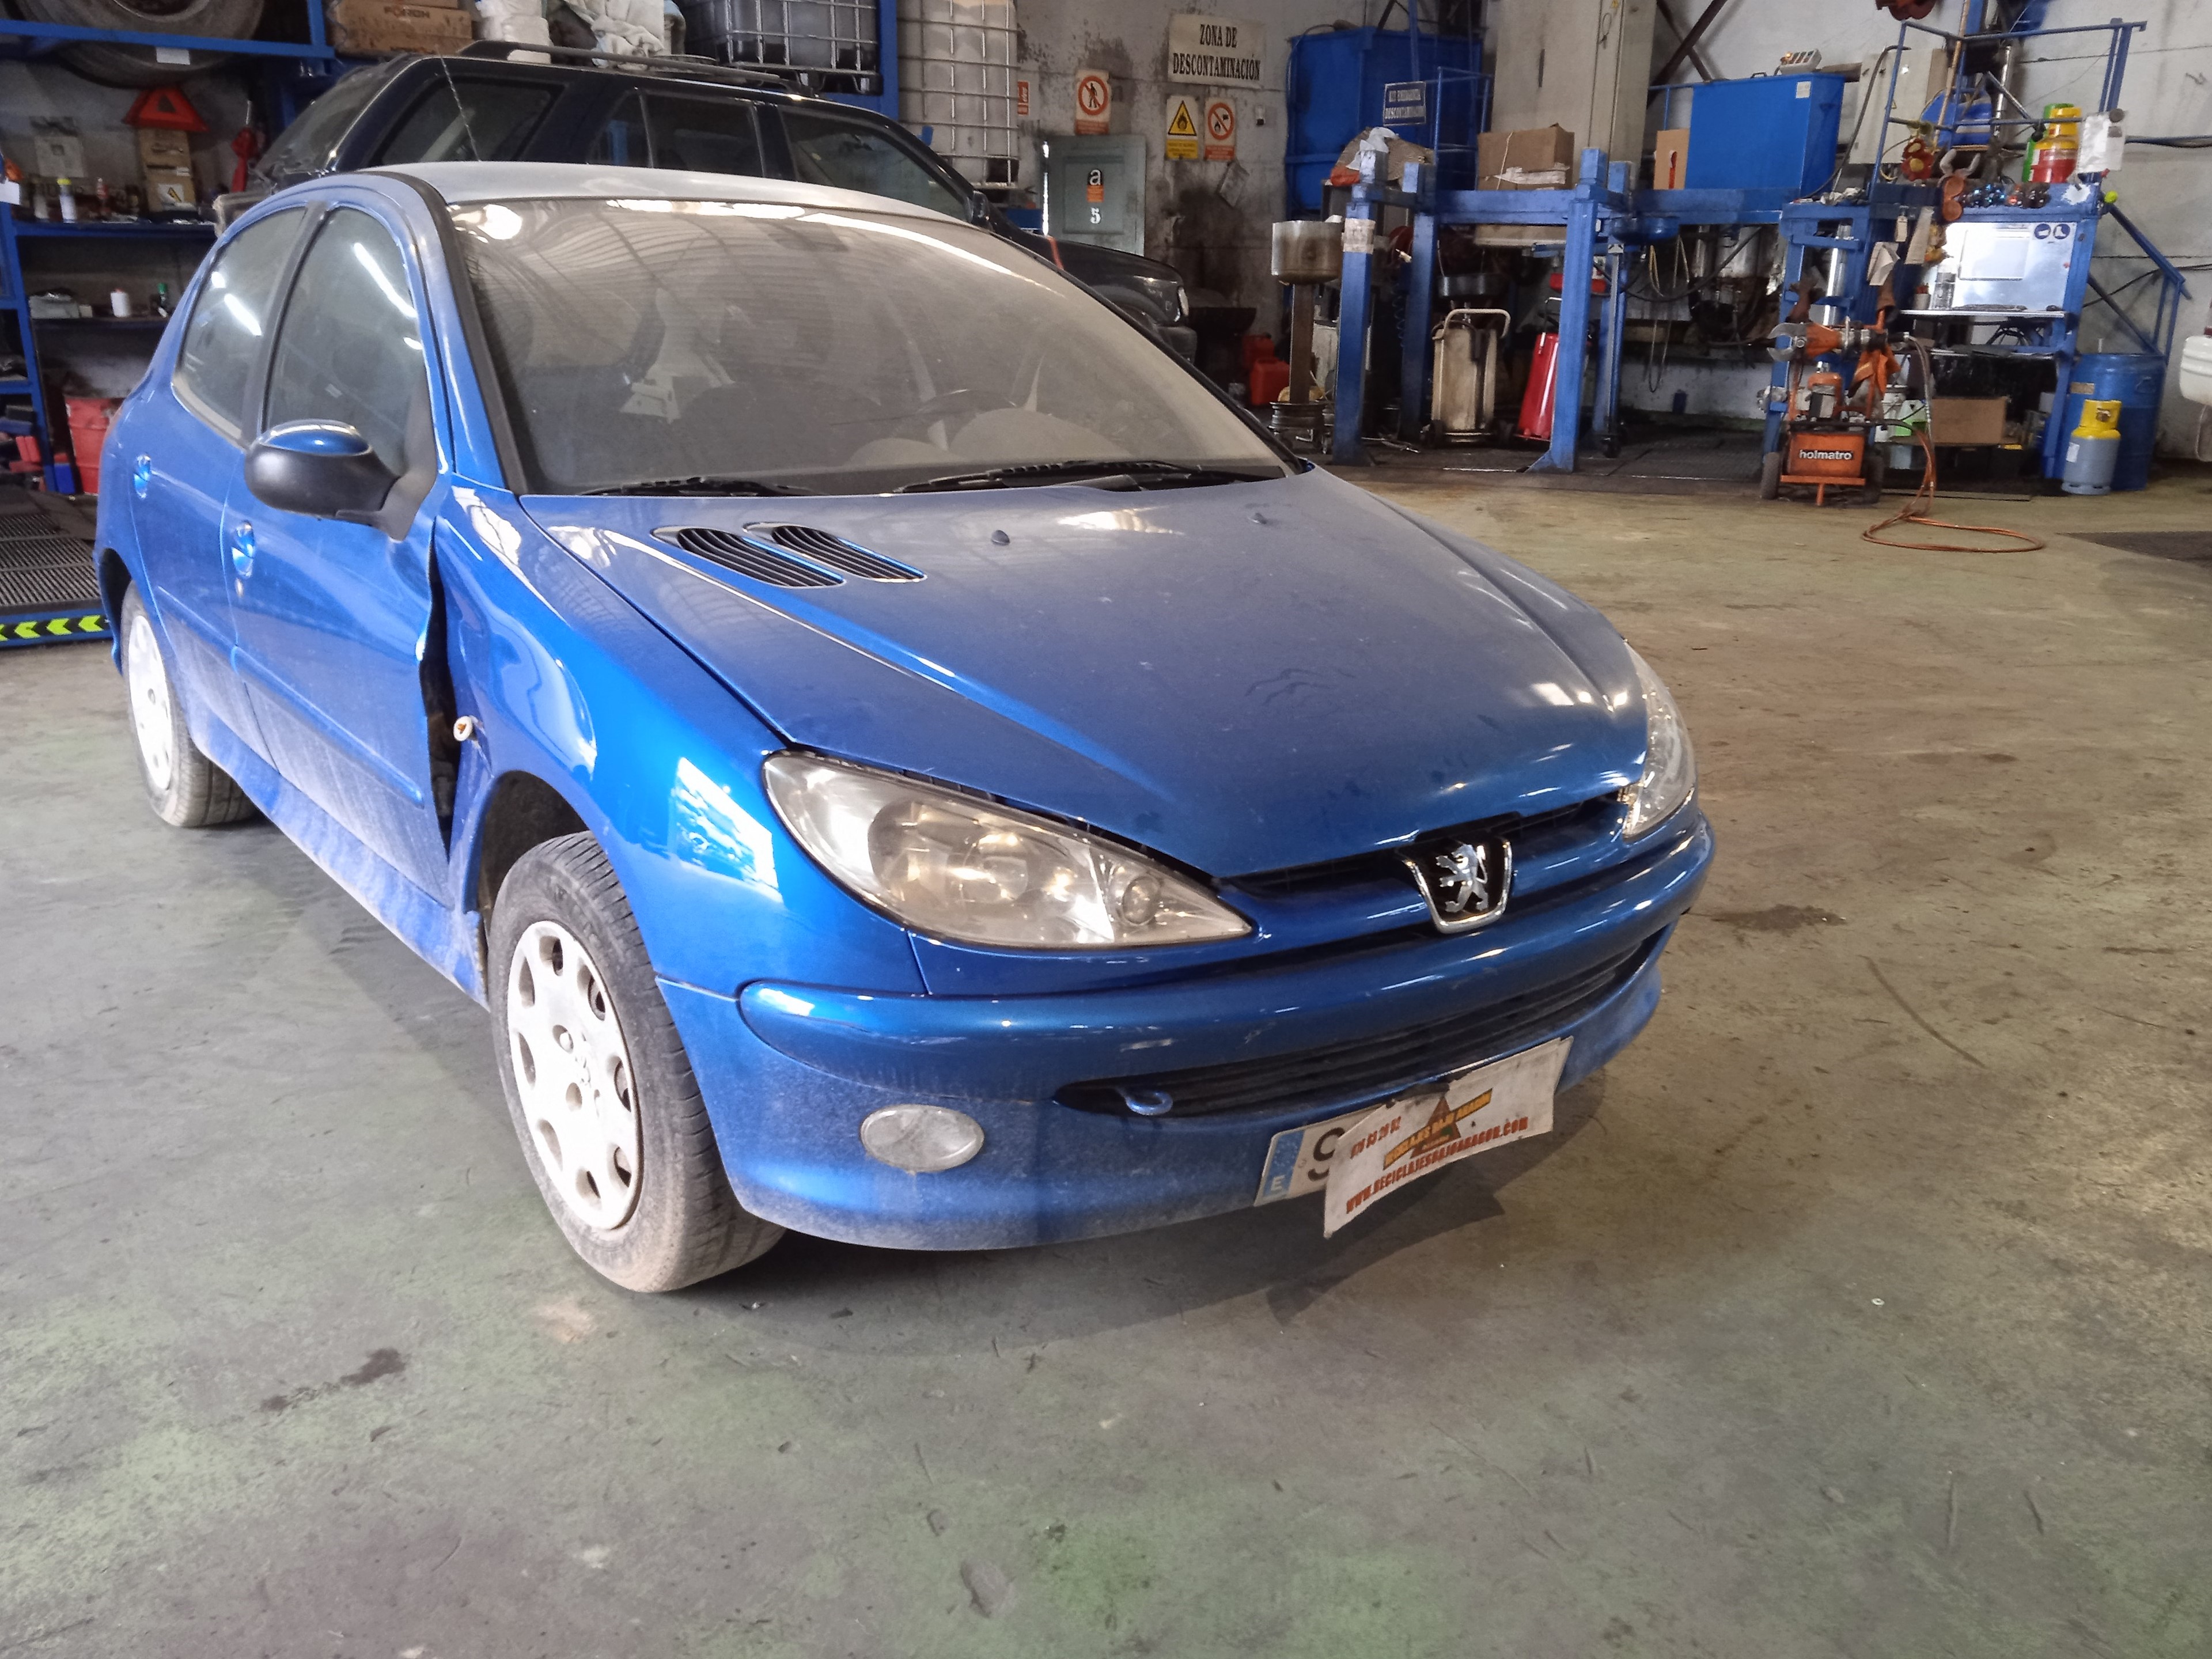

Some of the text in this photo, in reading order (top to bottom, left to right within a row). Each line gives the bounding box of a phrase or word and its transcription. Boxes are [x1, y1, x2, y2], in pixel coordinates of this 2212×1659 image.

[1200, 24, 1237, 48] ZONA DE
[1173, 52, 1261, 81] DESCONTAMINACIÓN
[1090, 207, 1101, 224] 5
[1800, 449, 1853, 460] holmatro
[1271, 1175, 1285, 1191] E
